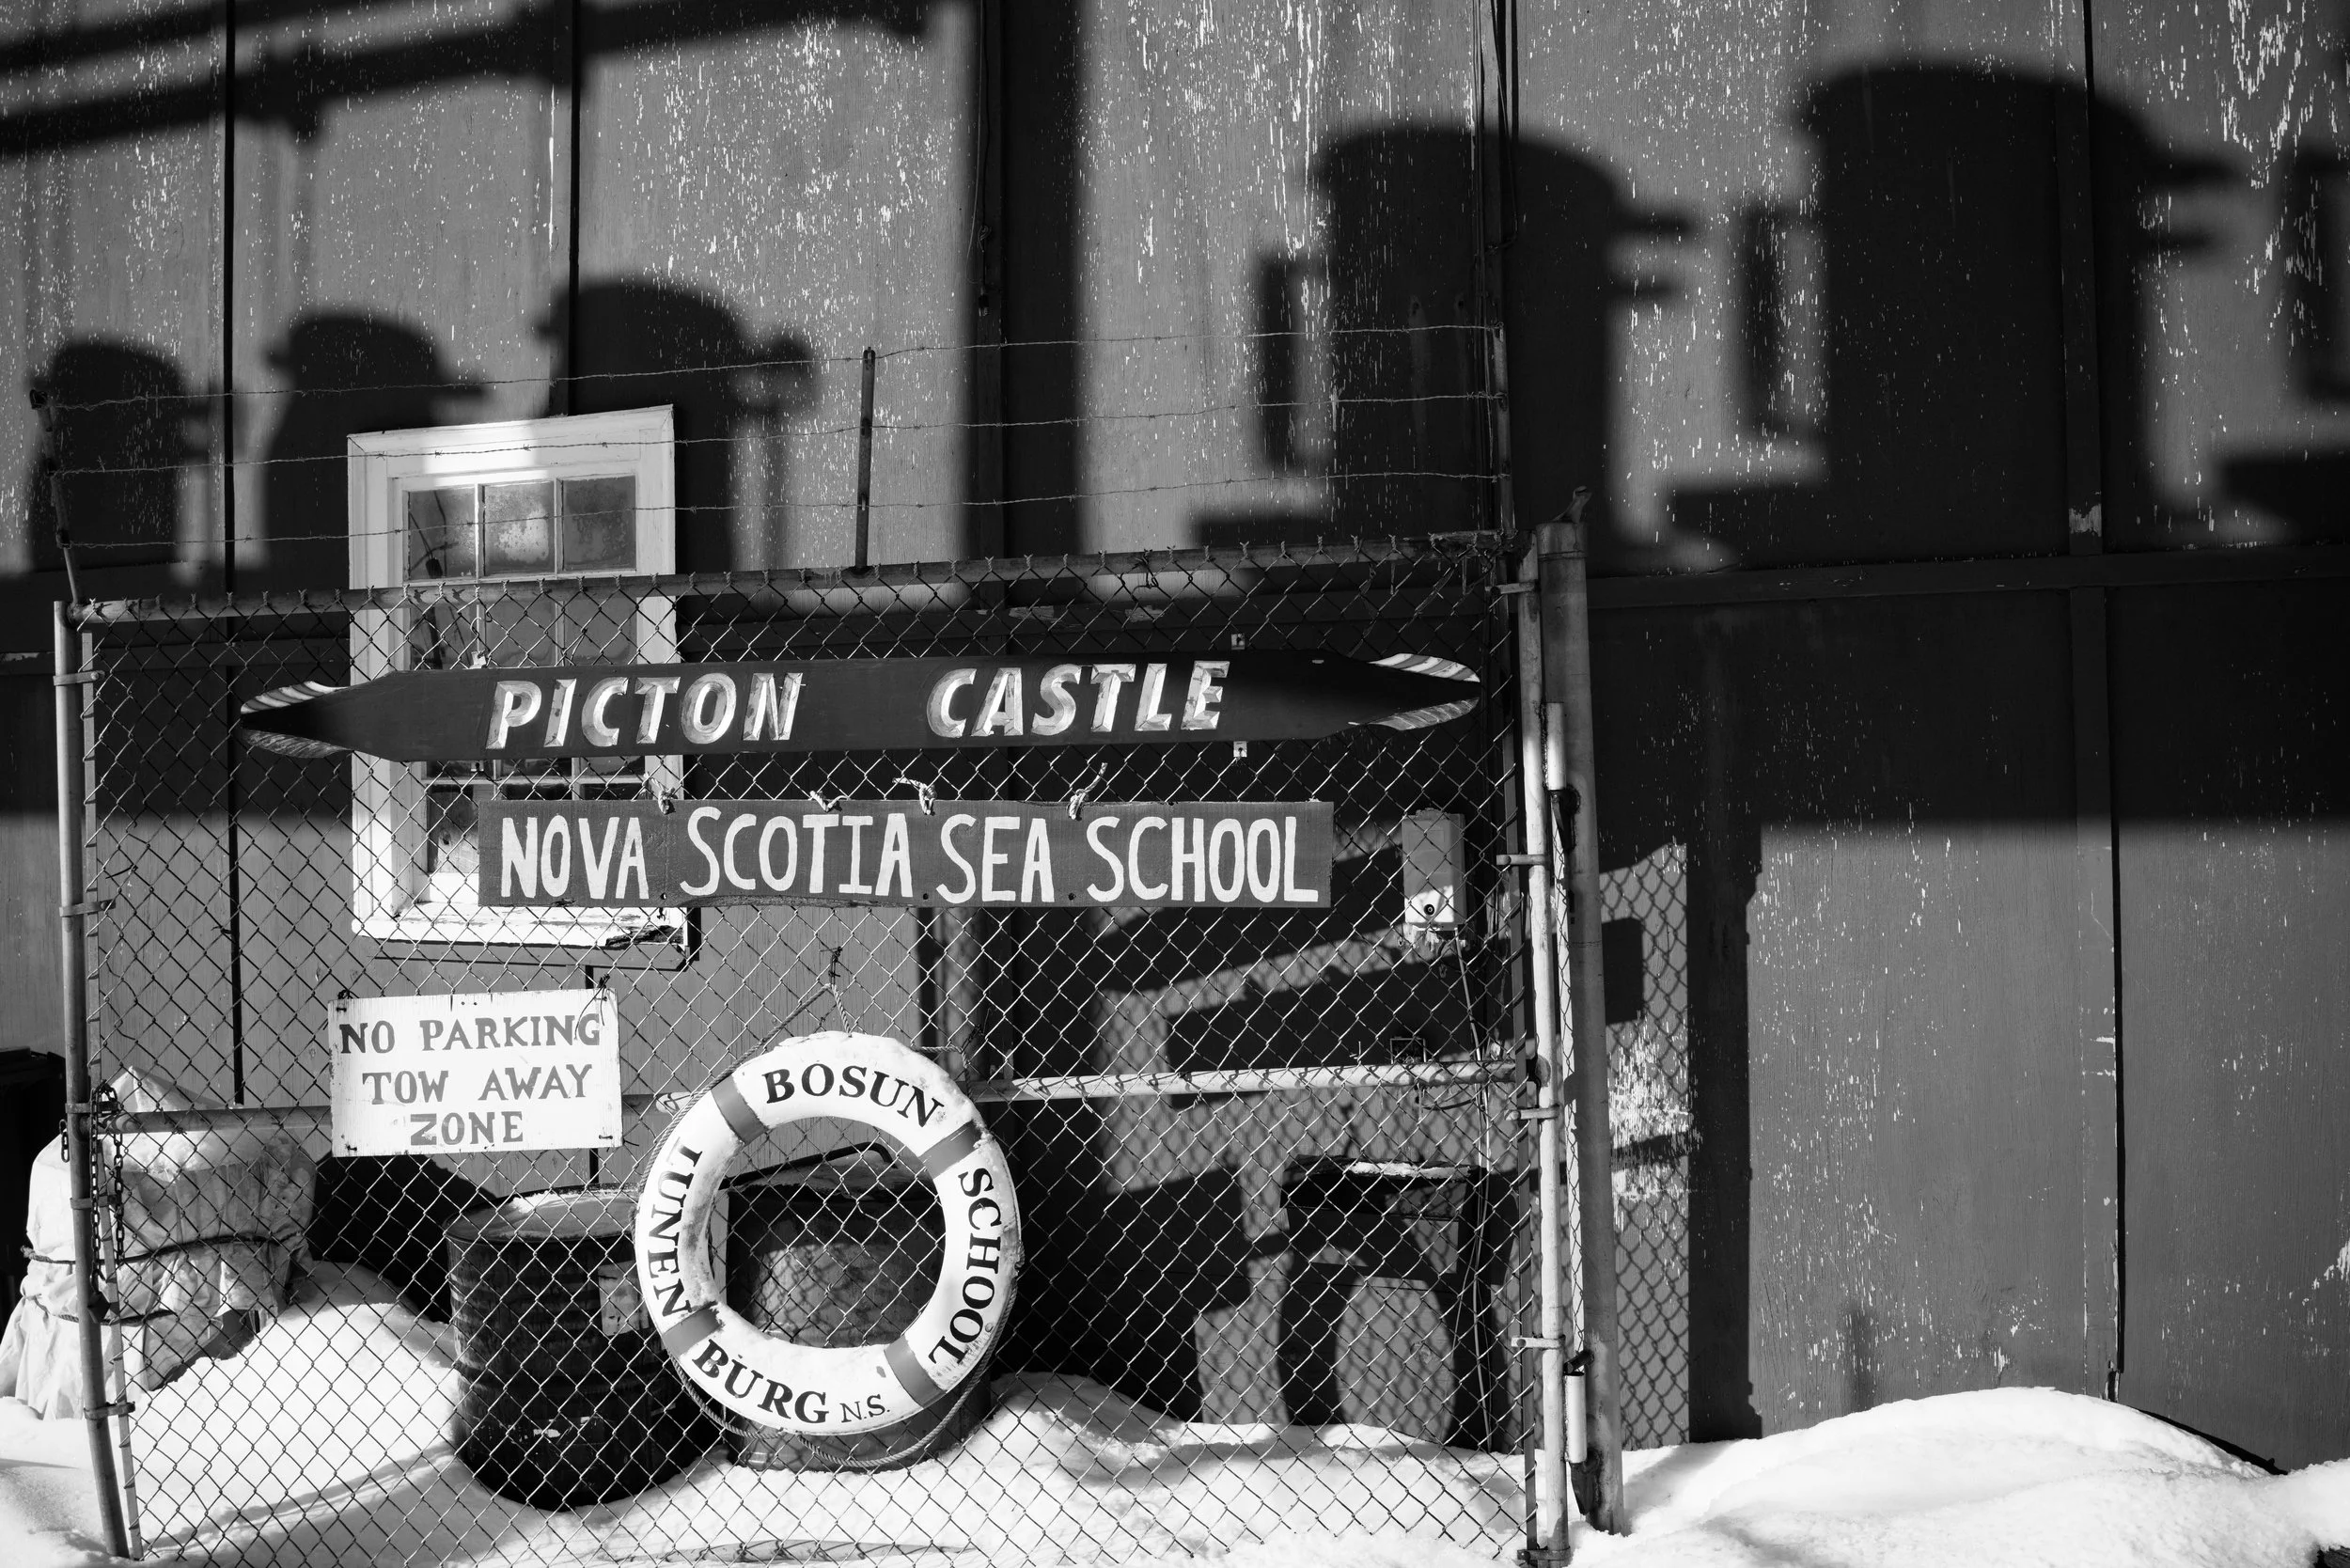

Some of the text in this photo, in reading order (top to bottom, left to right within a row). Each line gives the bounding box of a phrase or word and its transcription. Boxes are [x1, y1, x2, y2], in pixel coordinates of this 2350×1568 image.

[485, 660, 1230, 749] PICTON CASTLE
[501, 806, 1319, 903] NOVA SCOTIA SEA SCHOOL
[338, 1013, 601, 1054] NO PARKING
[362, 1064, 593, 1105] TOW AWAY
[410, 1110, 524, 1146] ZONE
[761, 1063, 1002, 1367] BOSUN SCHOOL
[692, 1339, 830, 1423] BURG
[839, 1393, 891, 1423] N.S.
